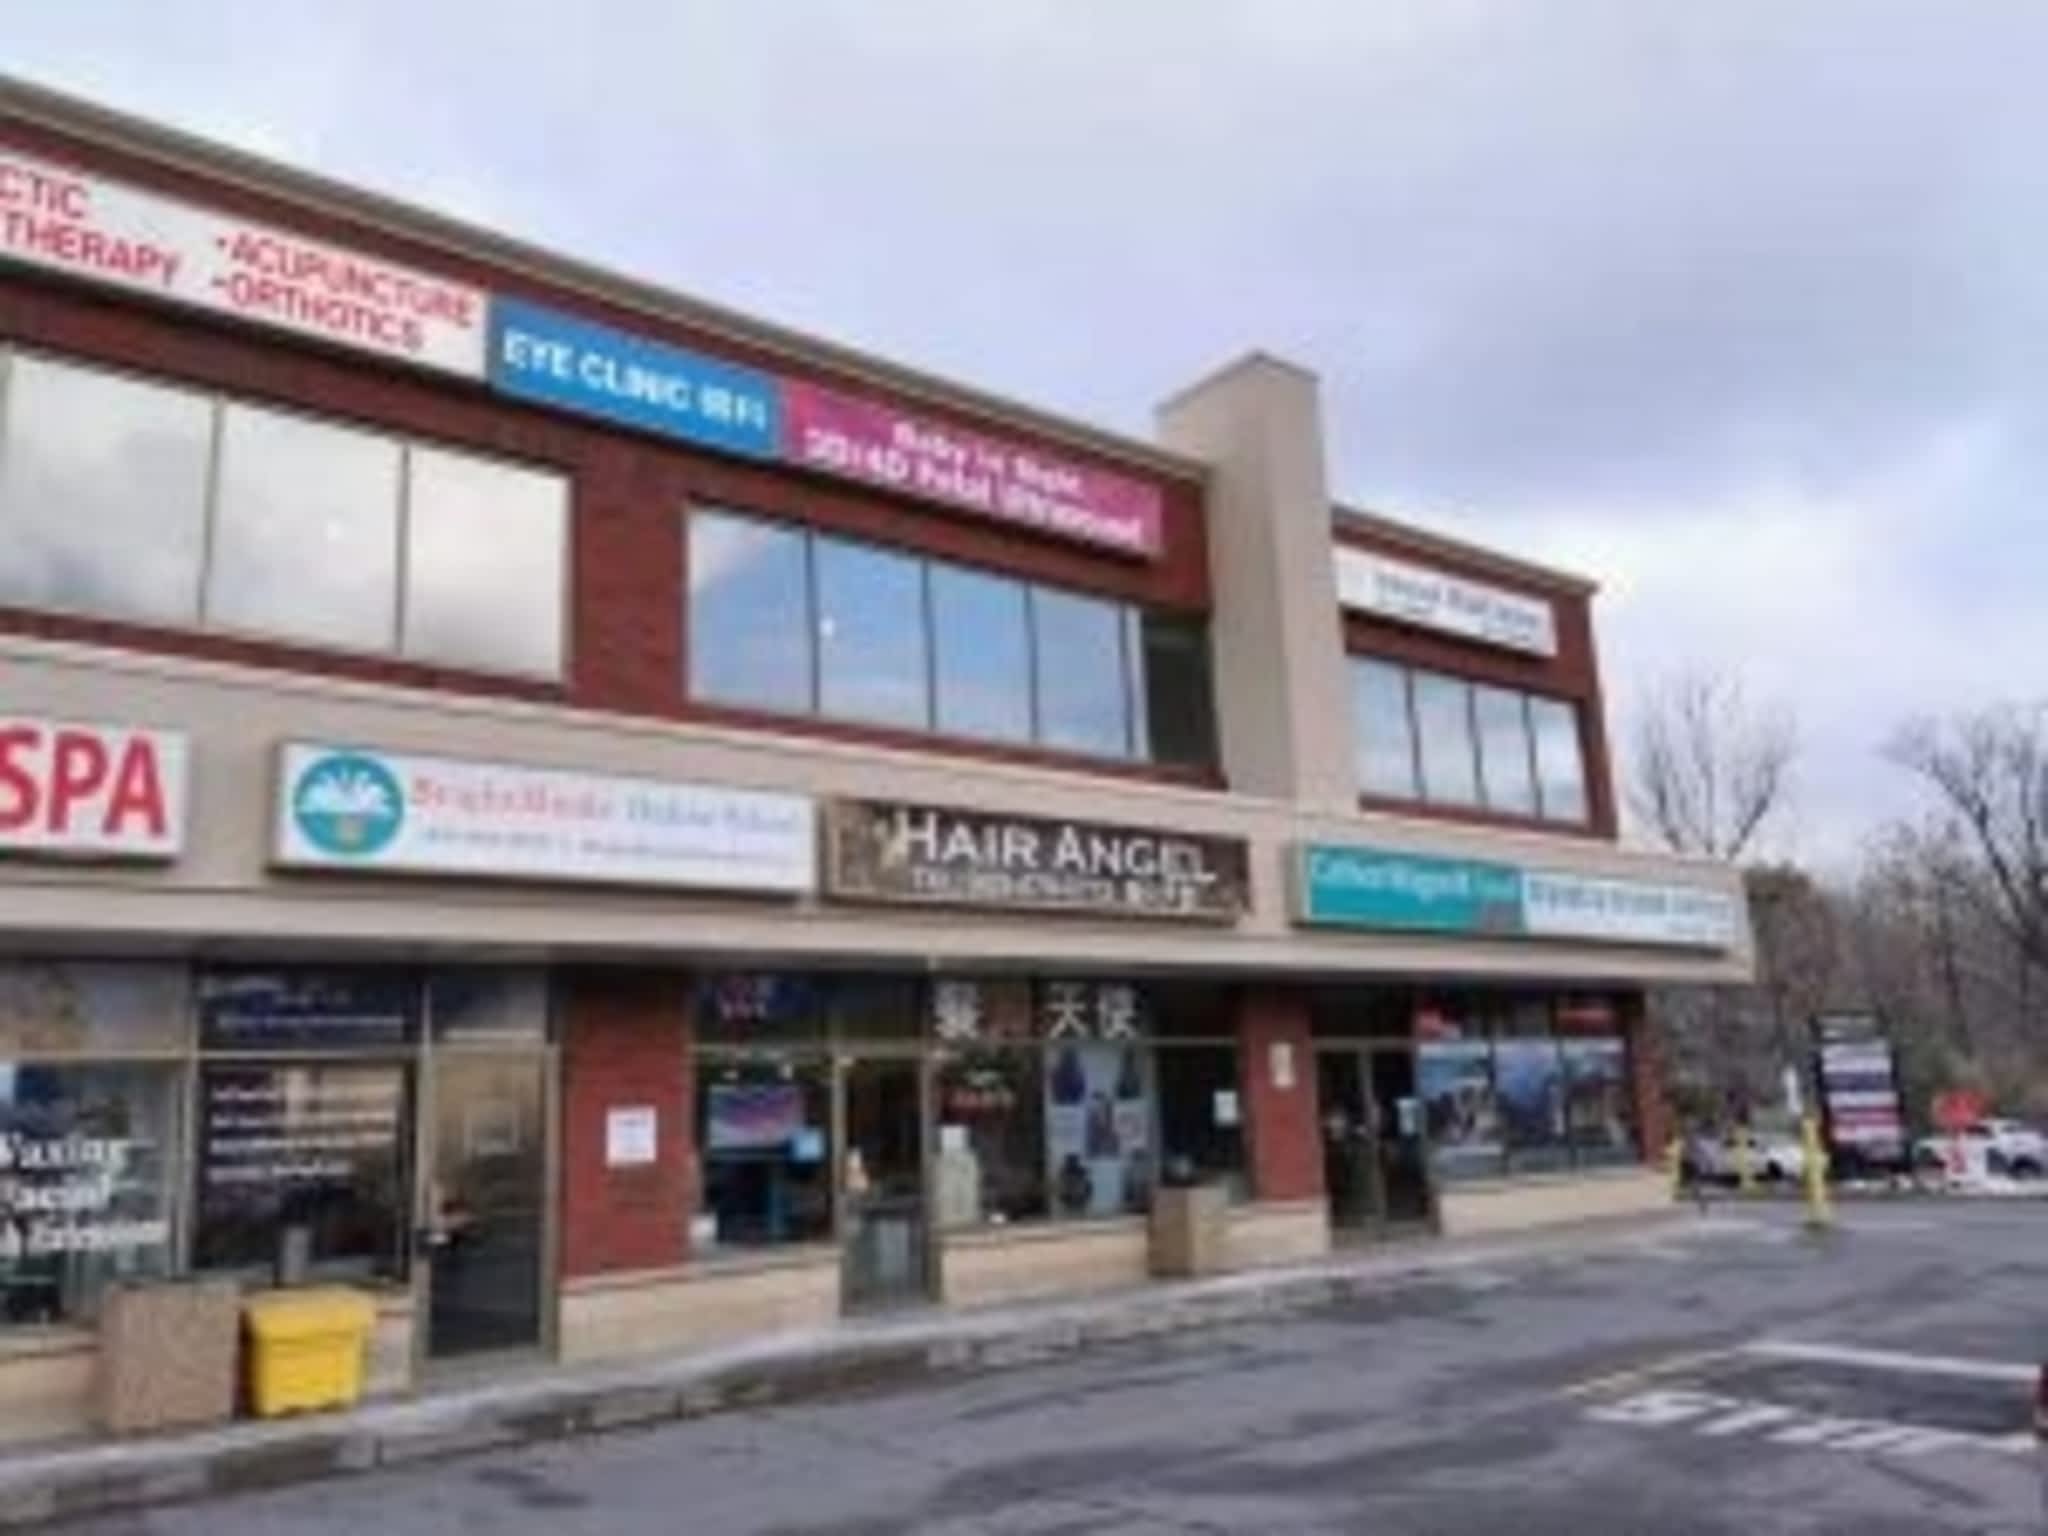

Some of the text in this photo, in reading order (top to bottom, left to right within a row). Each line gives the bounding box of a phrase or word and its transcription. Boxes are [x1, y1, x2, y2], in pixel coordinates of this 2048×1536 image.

[6, 208, 184, 287] THERAPY
[230, 231, 474, 329] ACUPUNCTURE
[228, 270, 426, 351] ORTHOTICS
[502, 325, 575, 381] EYE
[577, 350, 693, 413] CLINIC
[0, 727, 168, 839] SPA
[896, 810, 1217, 884] HAIR ANGEL
